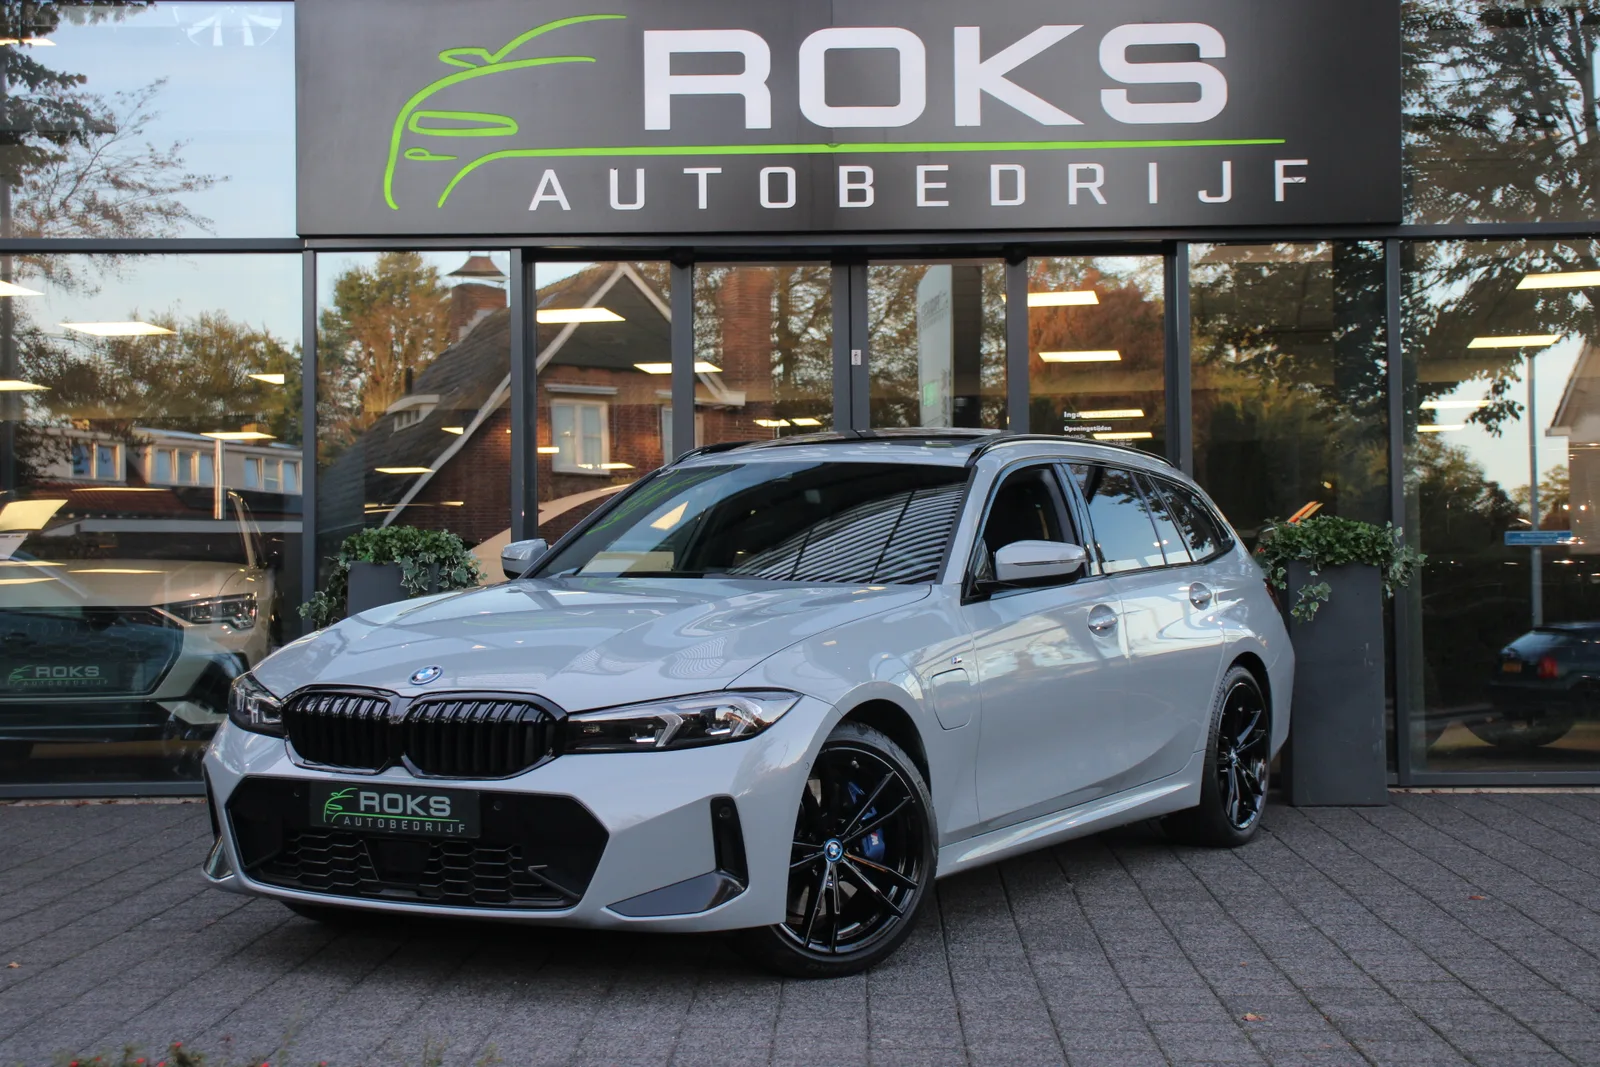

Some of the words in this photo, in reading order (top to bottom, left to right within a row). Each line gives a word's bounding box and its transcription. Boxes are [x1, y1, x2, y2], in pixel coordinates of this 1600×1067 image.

[643, 22, 1229, 131] ROKS
[529, 159, 1309, 211] AUTOBEDRIJF
[35, 666, 100, 678] ROKS
[359, 791, 452, 817] ROKS
[344, 816, 466, 833] AUTOBEDRIJF
